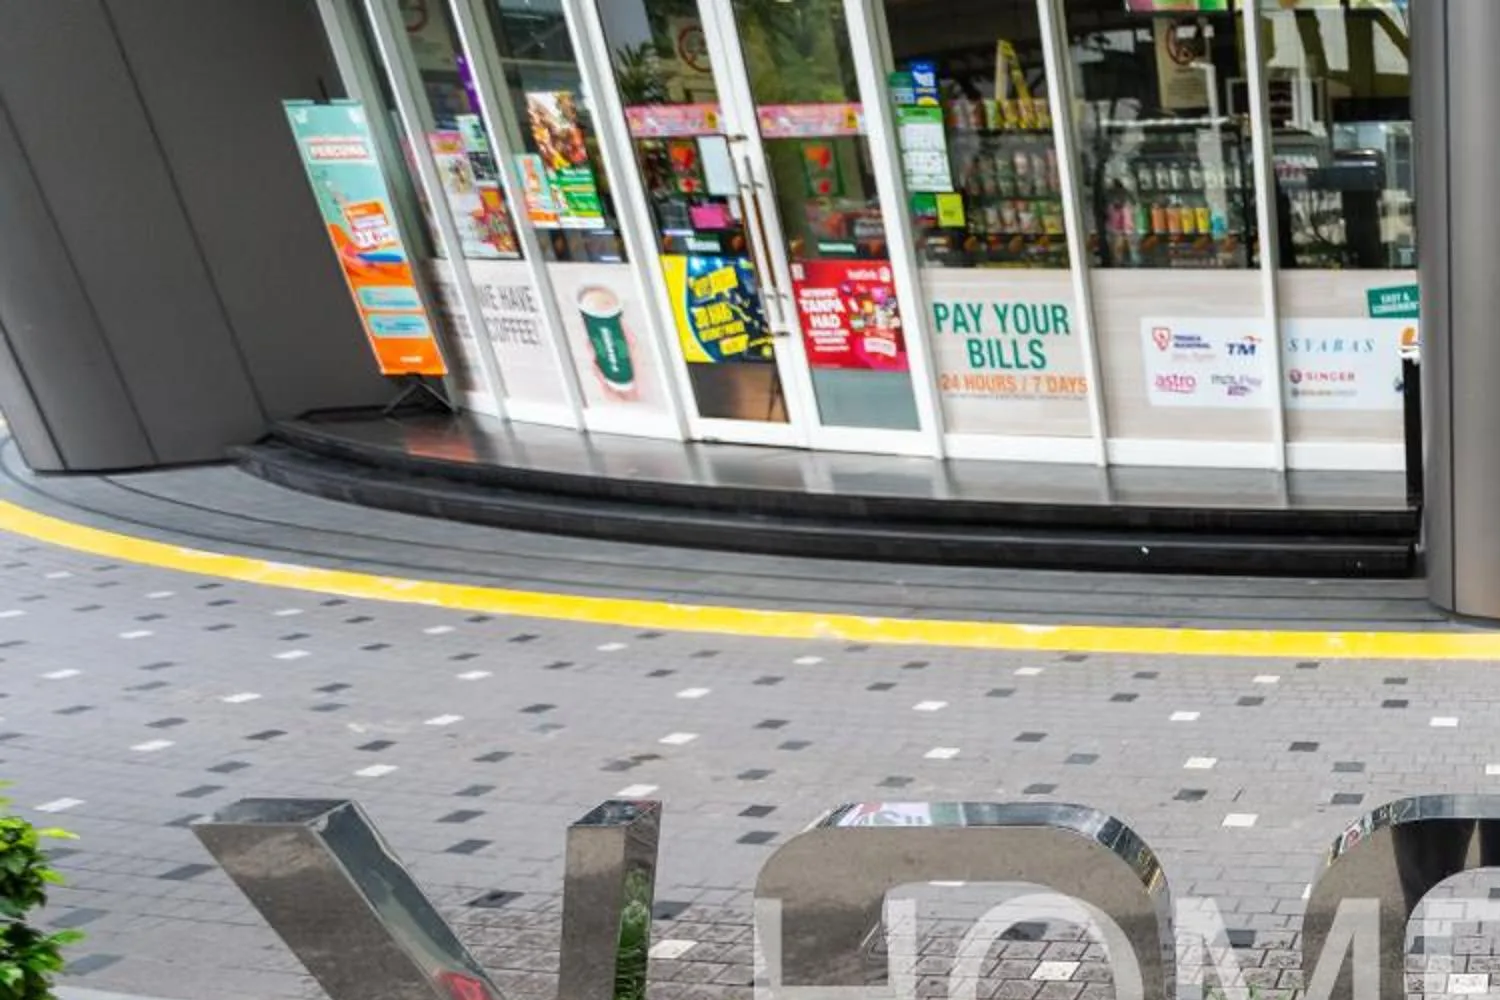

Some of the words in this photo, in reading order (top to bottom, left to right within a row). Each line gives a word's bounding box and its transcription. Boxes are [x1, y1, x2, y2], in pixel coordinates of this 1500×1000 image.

[933, 303, 983, 333] PAY
[993, 303, 1070, 335] YOUR
[967, 338, 1047, 370] BILLS
[1226, 342, 1257, 356] TM
[939, 374, 961, 391] 24
[964, 374, 1018, 393] HOURS
[1032, 376, 1042, 393] 7
[1047, 375, 1089, 394] DAYS
[1155, 374, 1197, 390] astro
[1305, 371, 1356, 382] SINGER
